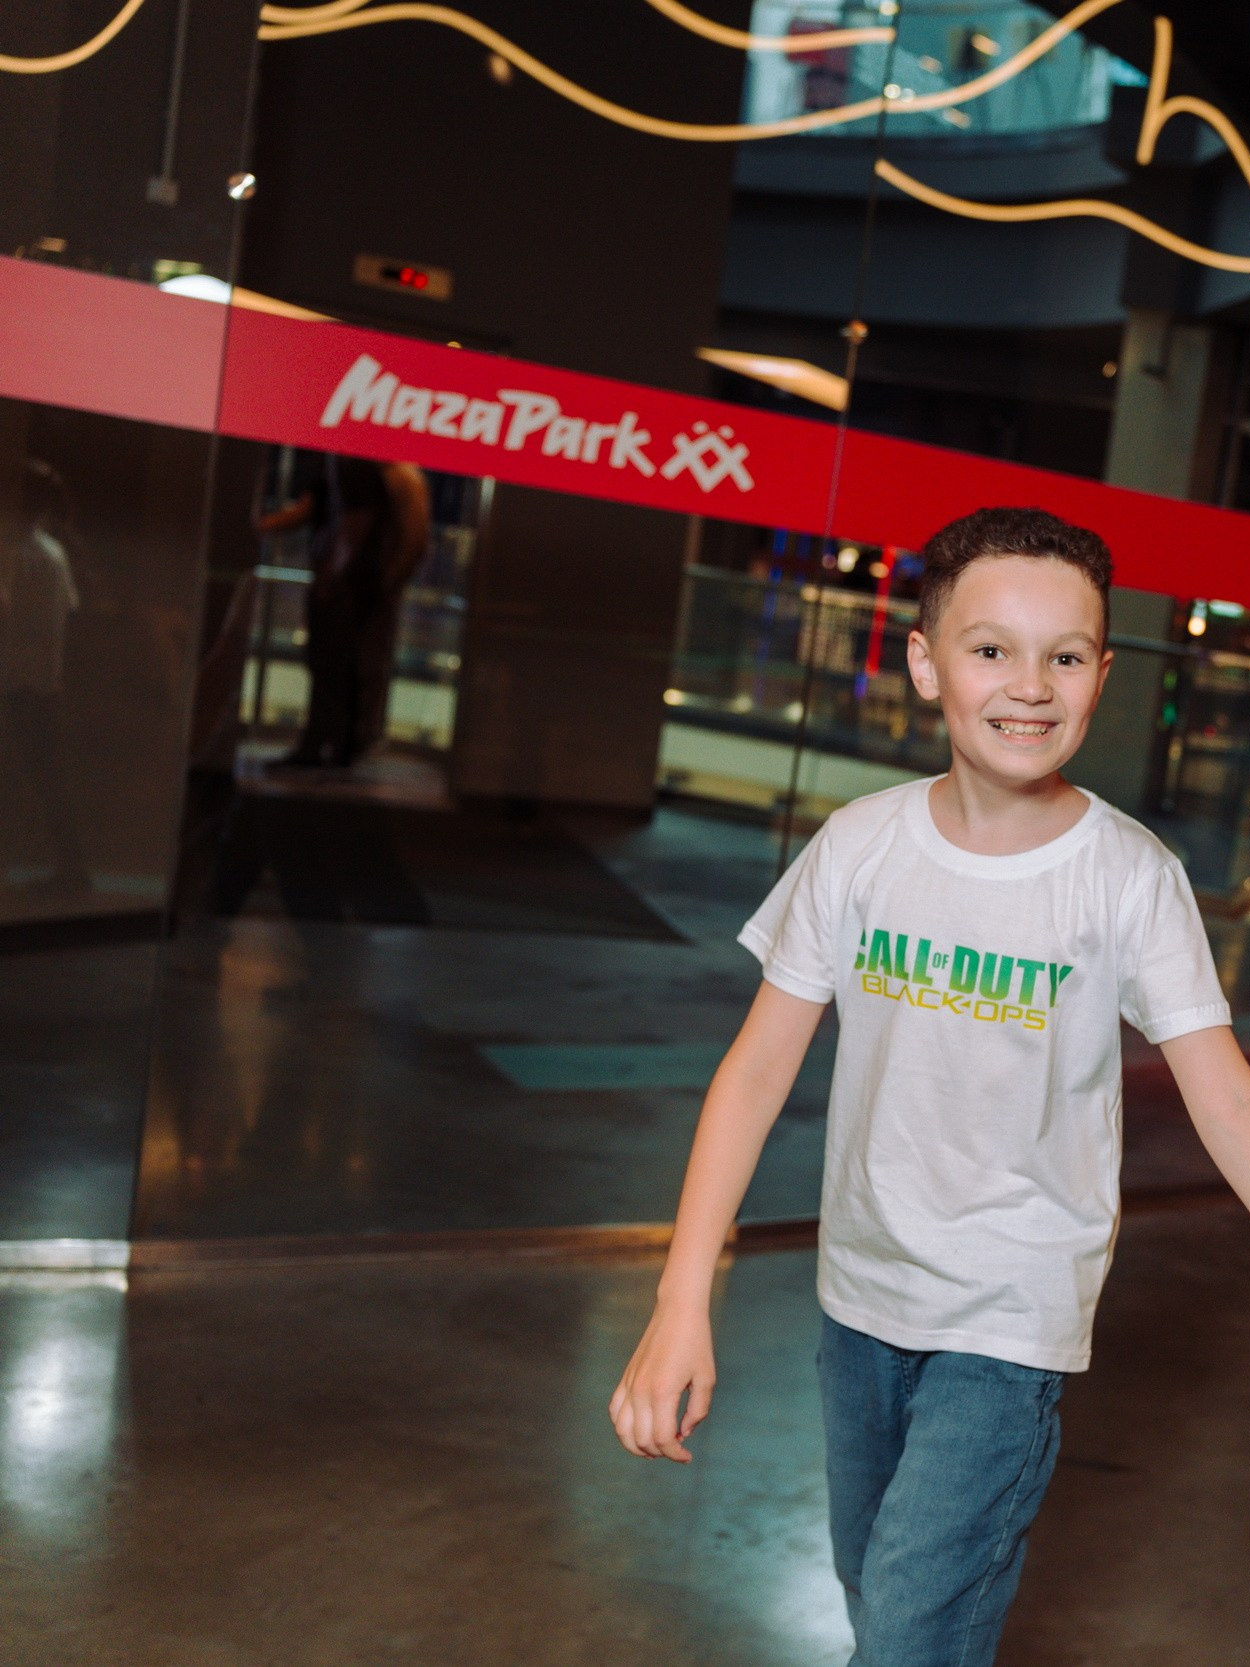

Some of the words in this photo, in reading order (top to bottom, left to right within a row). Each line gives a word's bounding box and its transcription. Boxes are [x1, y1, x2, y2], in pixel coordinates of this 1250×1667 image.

[319, 353, 656, 478] MazaPark
[861, 973, 964, 1014] BLACK
[973, 1000, 1047, 1031] OPS
[932, 952, 950, 970] OF
[949, 945, 1074, 1008] DUTY
